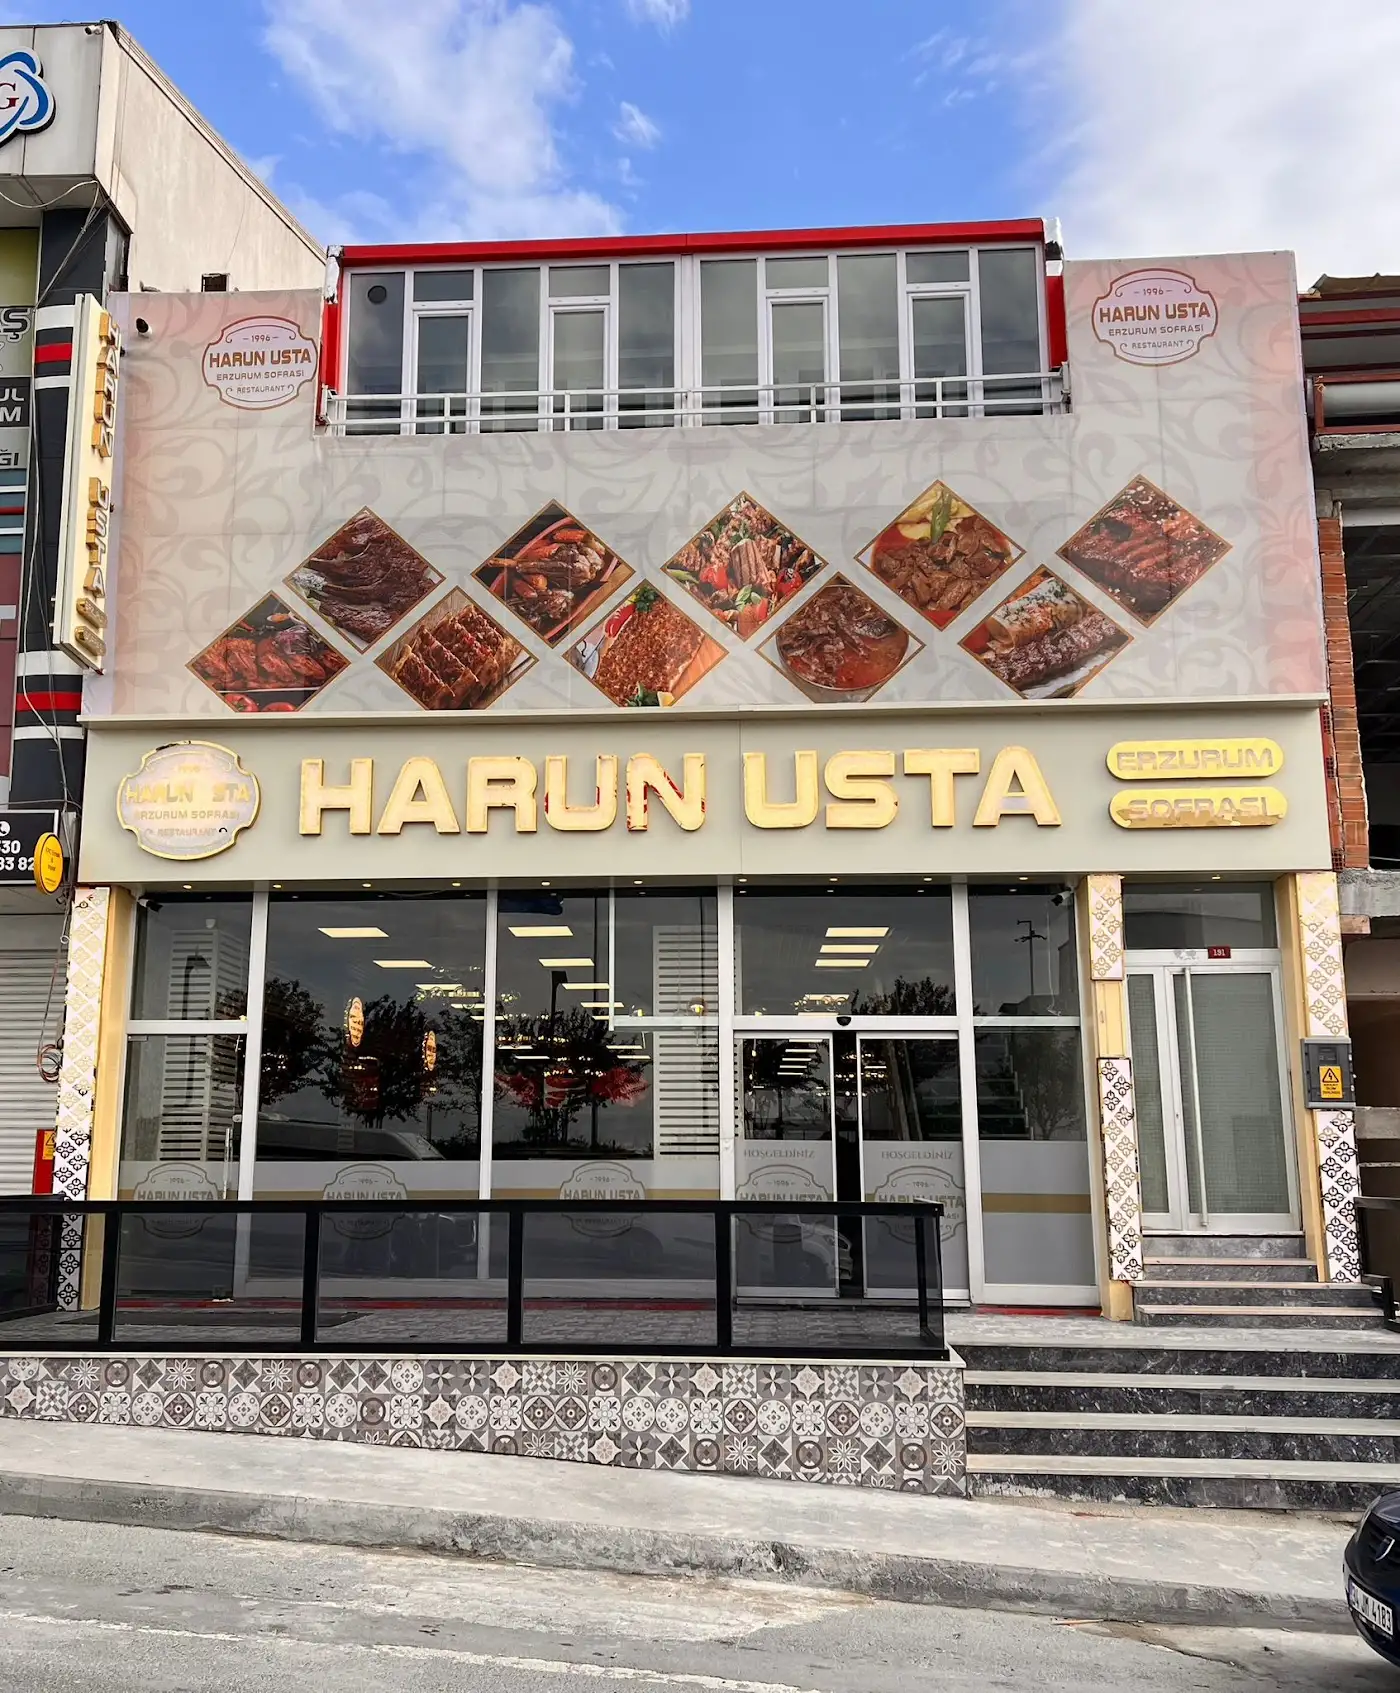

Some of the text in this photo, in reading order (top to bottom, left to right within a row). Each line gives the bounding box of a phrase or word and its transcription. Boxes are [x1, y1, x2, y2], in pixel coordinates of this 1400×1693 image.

[1143, 287, 1164, 296] 1996
[1099, 301, 1211, 322] HARUN USTA
[0, 308, 31, 341] Ş
[1108, 327, 1158, 336] ERZURUM
[251, 334, 271, 343] 1996
[1131, 340, 1184, 349] RESTAURANT
[209, 348, 312, 368] HARUN USTA
[216, 372, 262, 381] ERZURUM
[236, 385, 285, 394] RESTAURANT
[1116, 747, 1274, 771] ERZURUM
[299, 745, 1062, 835] HARUN USTA
[1126, 796, 1271, 821] SOFRASI
[0, 840, 21, 854] 30
